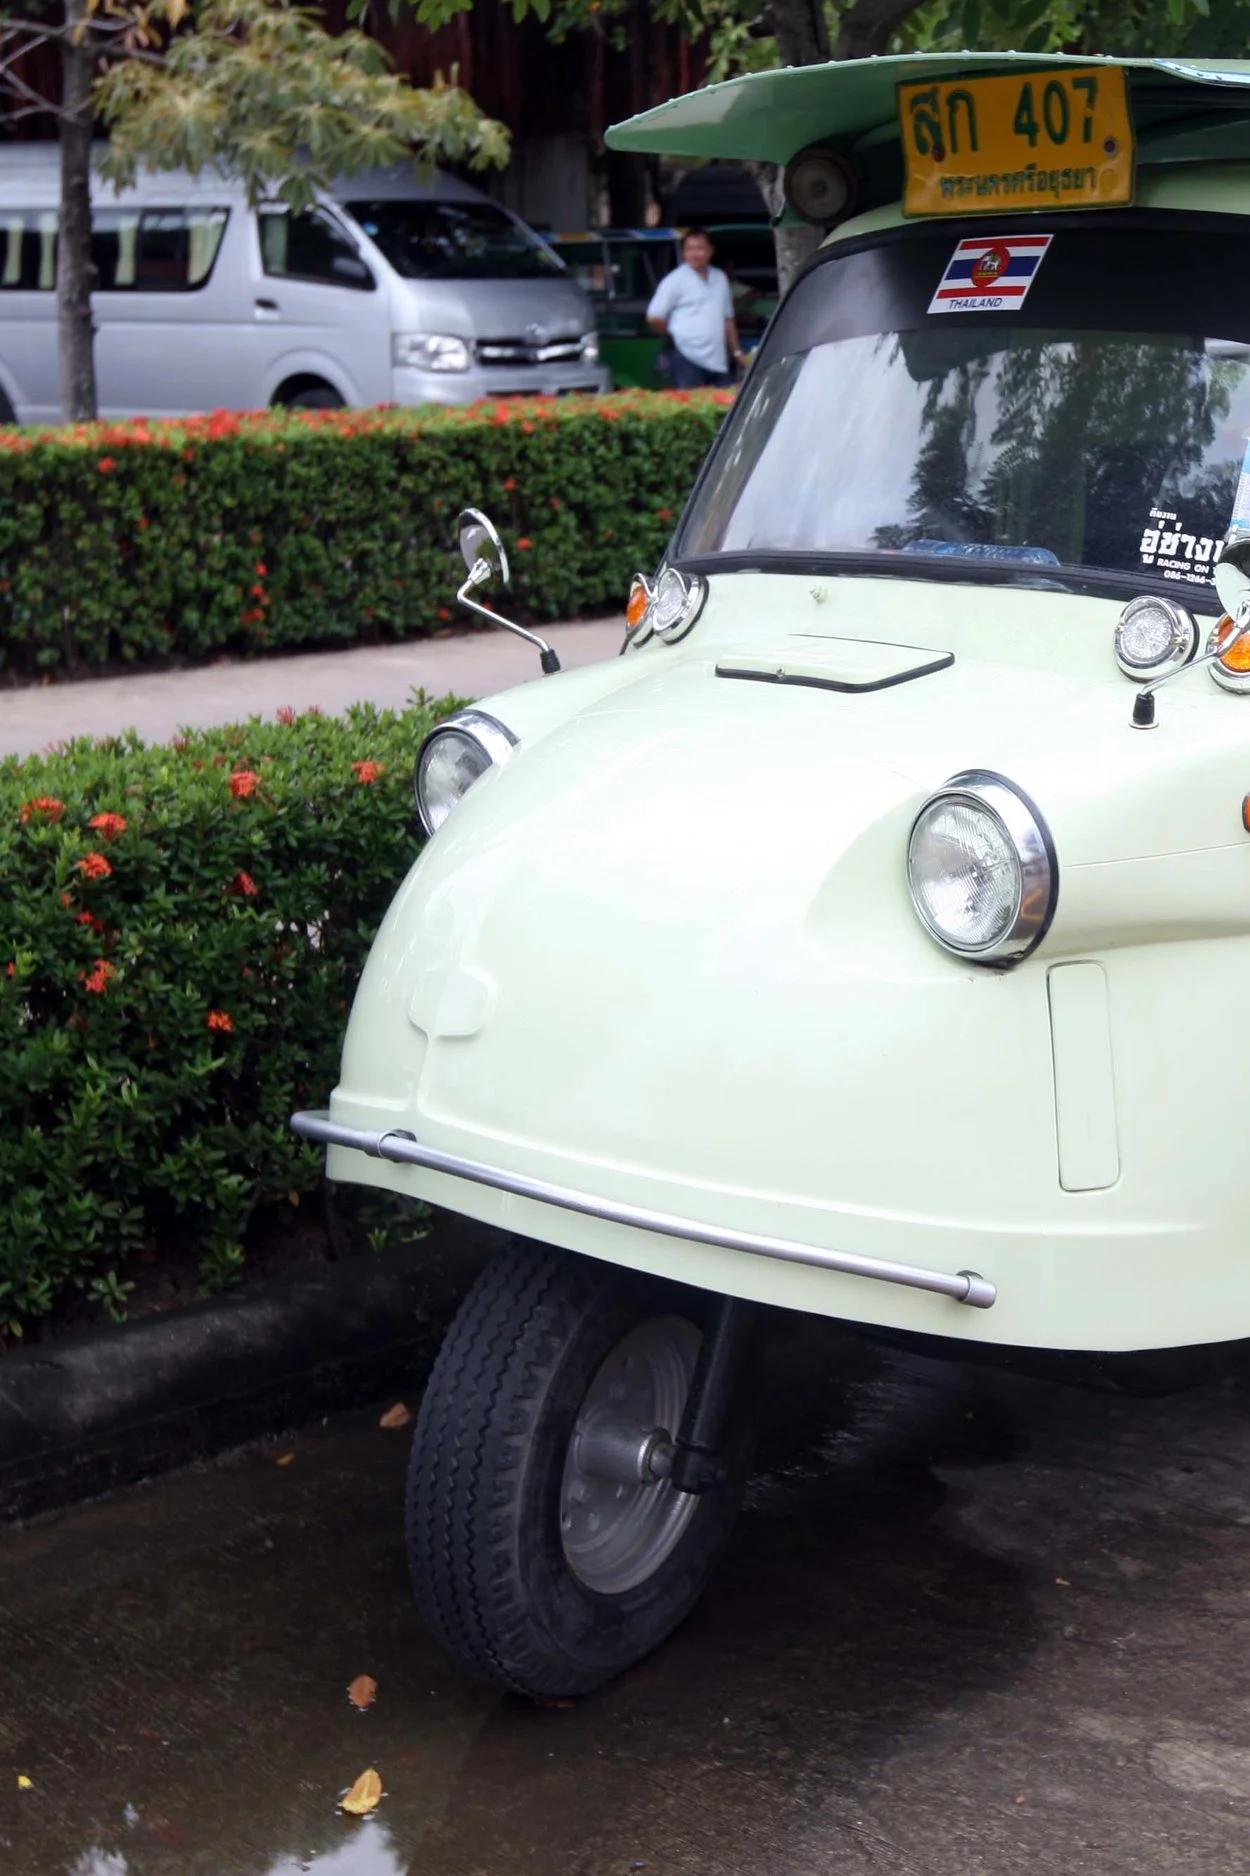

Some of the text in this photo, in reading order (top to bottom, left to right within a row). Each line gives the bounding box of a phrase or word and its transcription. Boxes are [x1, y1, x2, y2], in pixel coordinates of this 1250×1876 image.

[1014, 76, 1098, 148] 407
[948, 298, 1003, 309] THAILAND
[1156, 558, 1191, 571] RACING
[1194, 564, 1210, 574] ON
